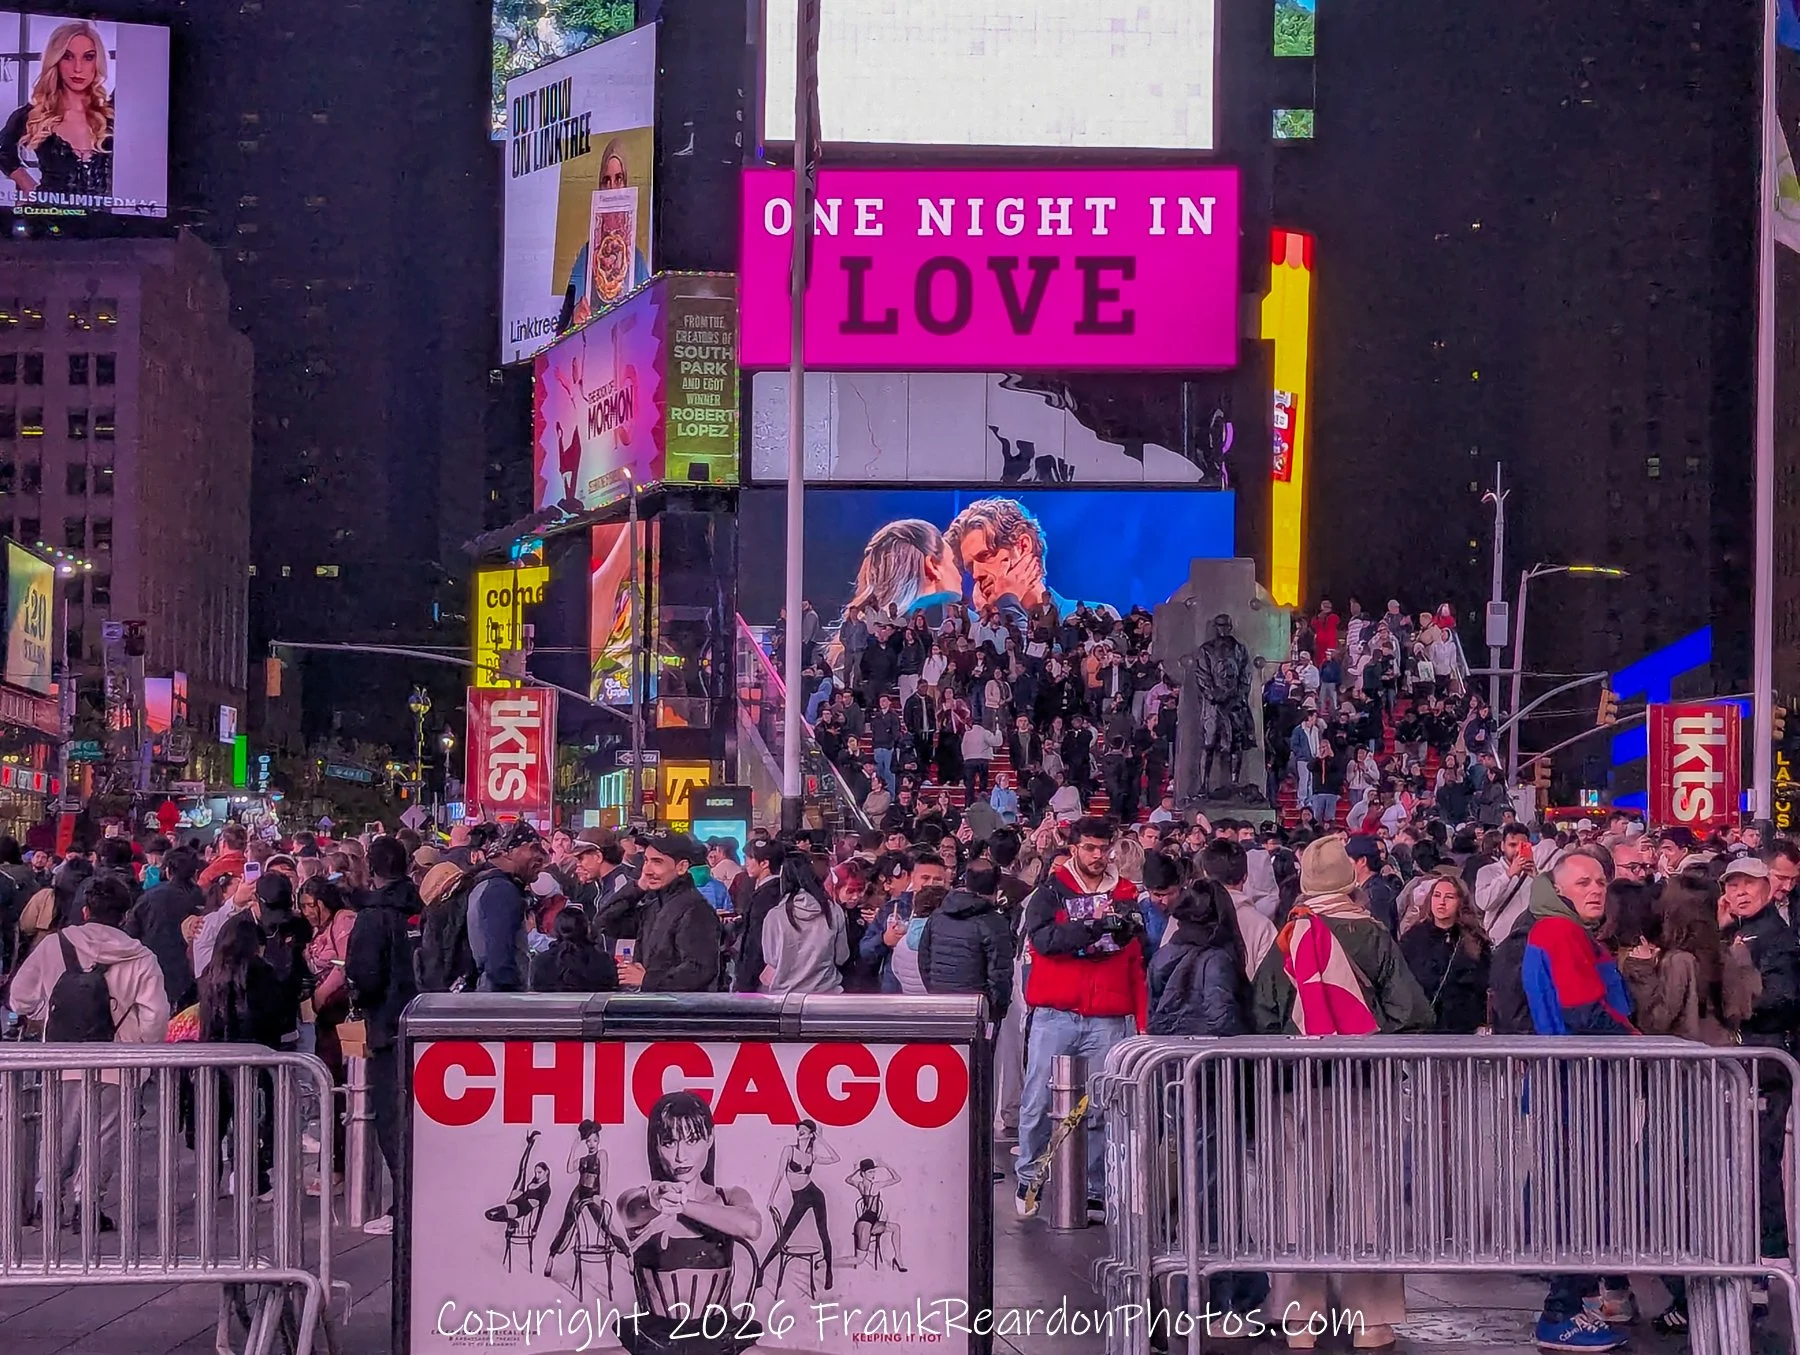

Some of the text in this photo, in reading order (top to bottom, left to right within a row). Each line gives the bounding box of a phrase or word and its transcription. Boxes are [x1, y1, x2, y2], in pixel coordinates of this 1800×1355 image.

[513, 76, 572, 137] OUT NOW
[512, 111, 592, 178] ON LINKTREE
[764, 196, 1216, 237] ONE NIGHT IN
[839, 255, 1137, 337] LOVE
[511, 316, 559, 344] Linktree
[684, 315, 709, 328] FROM
[676, 330, 733, 345] CREATORS OF
[673, 345, 734, 360] SOUTH
[680, 361, 728, 376] PARK
[682, 377, 725, 391] AND EGOT
[686, 393, 721, 406] WINNER
[588, 384, 634, 440] MORMON
[671, 407, 736, 422] ROBERT
[677, 423, 729, 437] LOPEZ
[488, 696, 541, 802] tkts
[1672, 712, 1727, 821] tkts
[413, 1041, 970, 1129] CHICAGO
[852, 1333, 902, 1342] KEEPING
[919, 1333, 942, 1342] HOT
